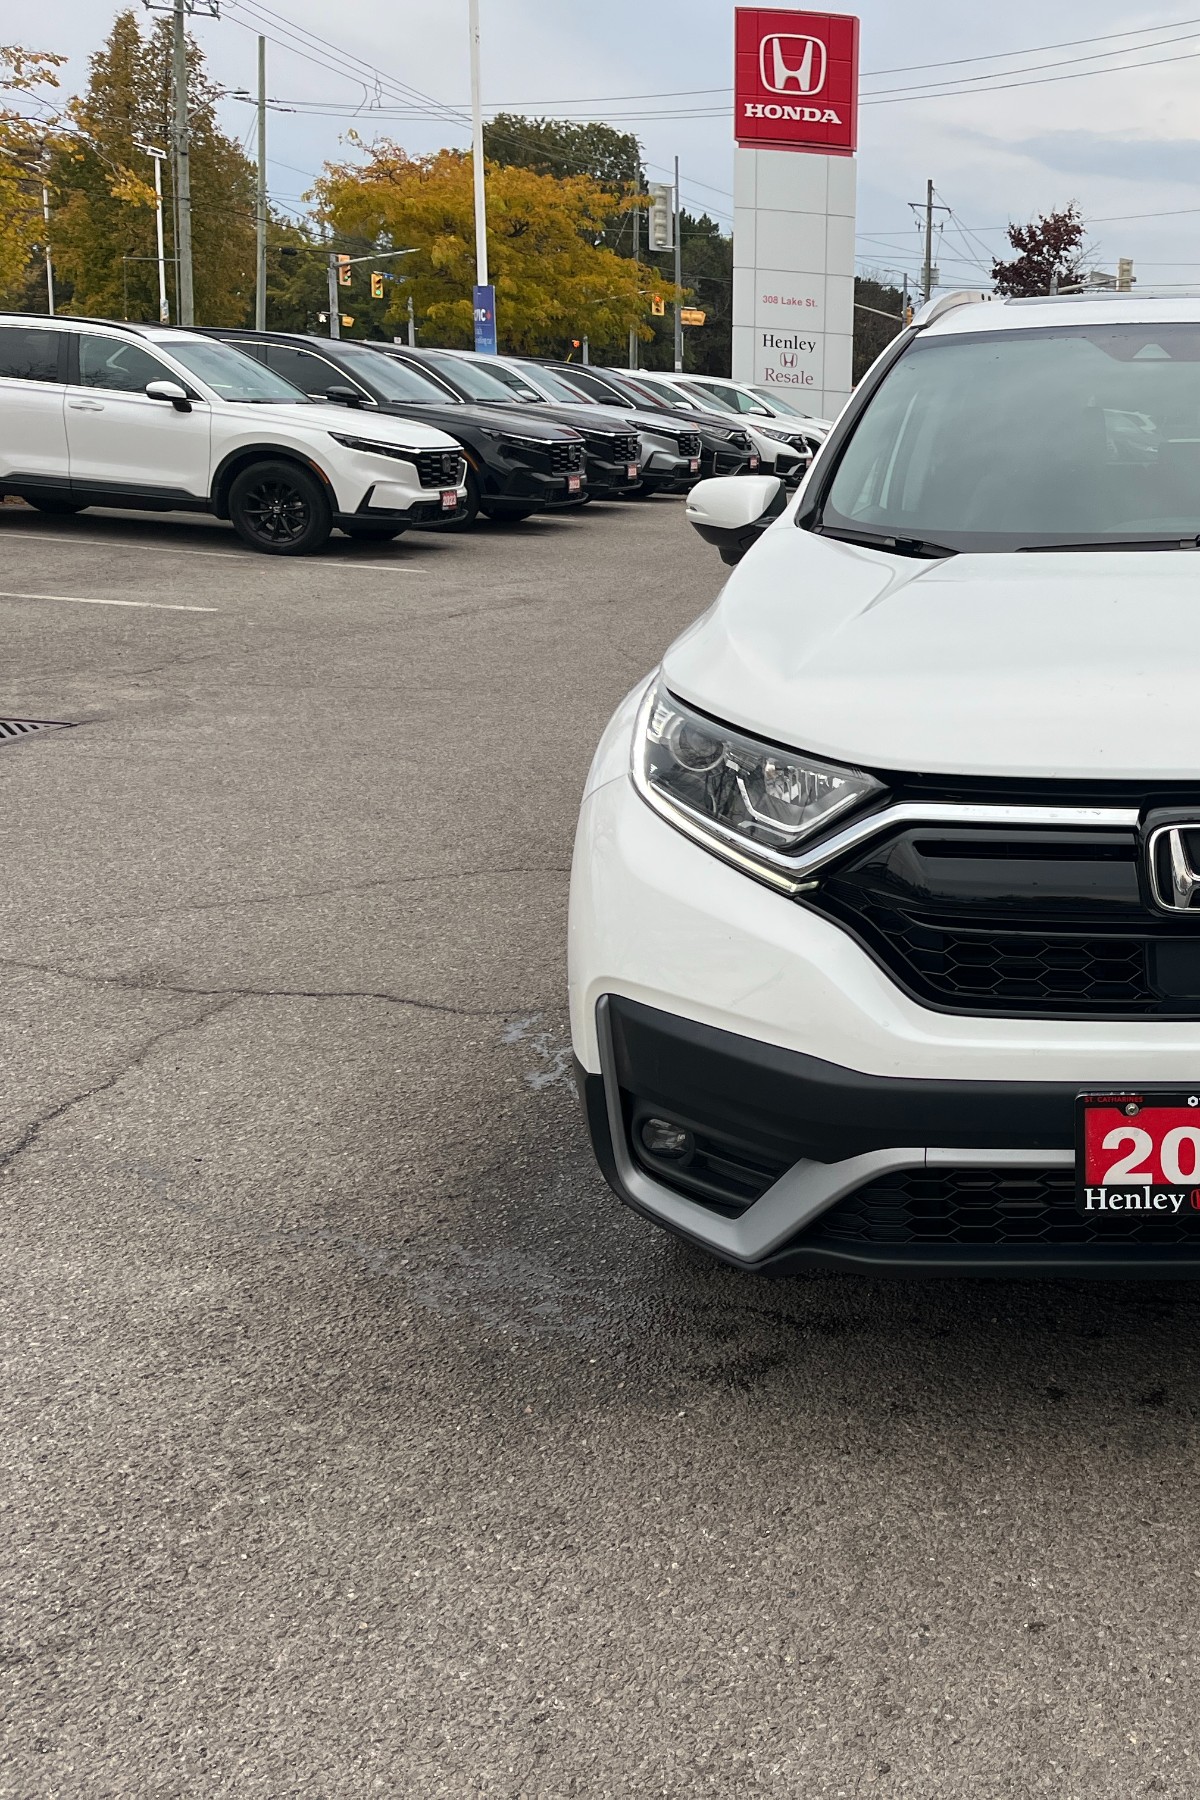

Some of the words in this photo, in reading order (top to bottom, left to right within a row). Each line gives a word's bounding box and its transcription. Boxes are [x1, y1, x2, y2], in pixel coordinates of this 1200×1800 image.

[744, 103, 842, 124] HONDA
[763, 295, 778, 304] 308
[781, 296, 802, 306] Lake
[806, 298, 817, 307] St.
[763, 334, 816, 353] Henley
[764, 367, 814, 385] Resale
[1084, 1186, 1185, 1213] Henley
